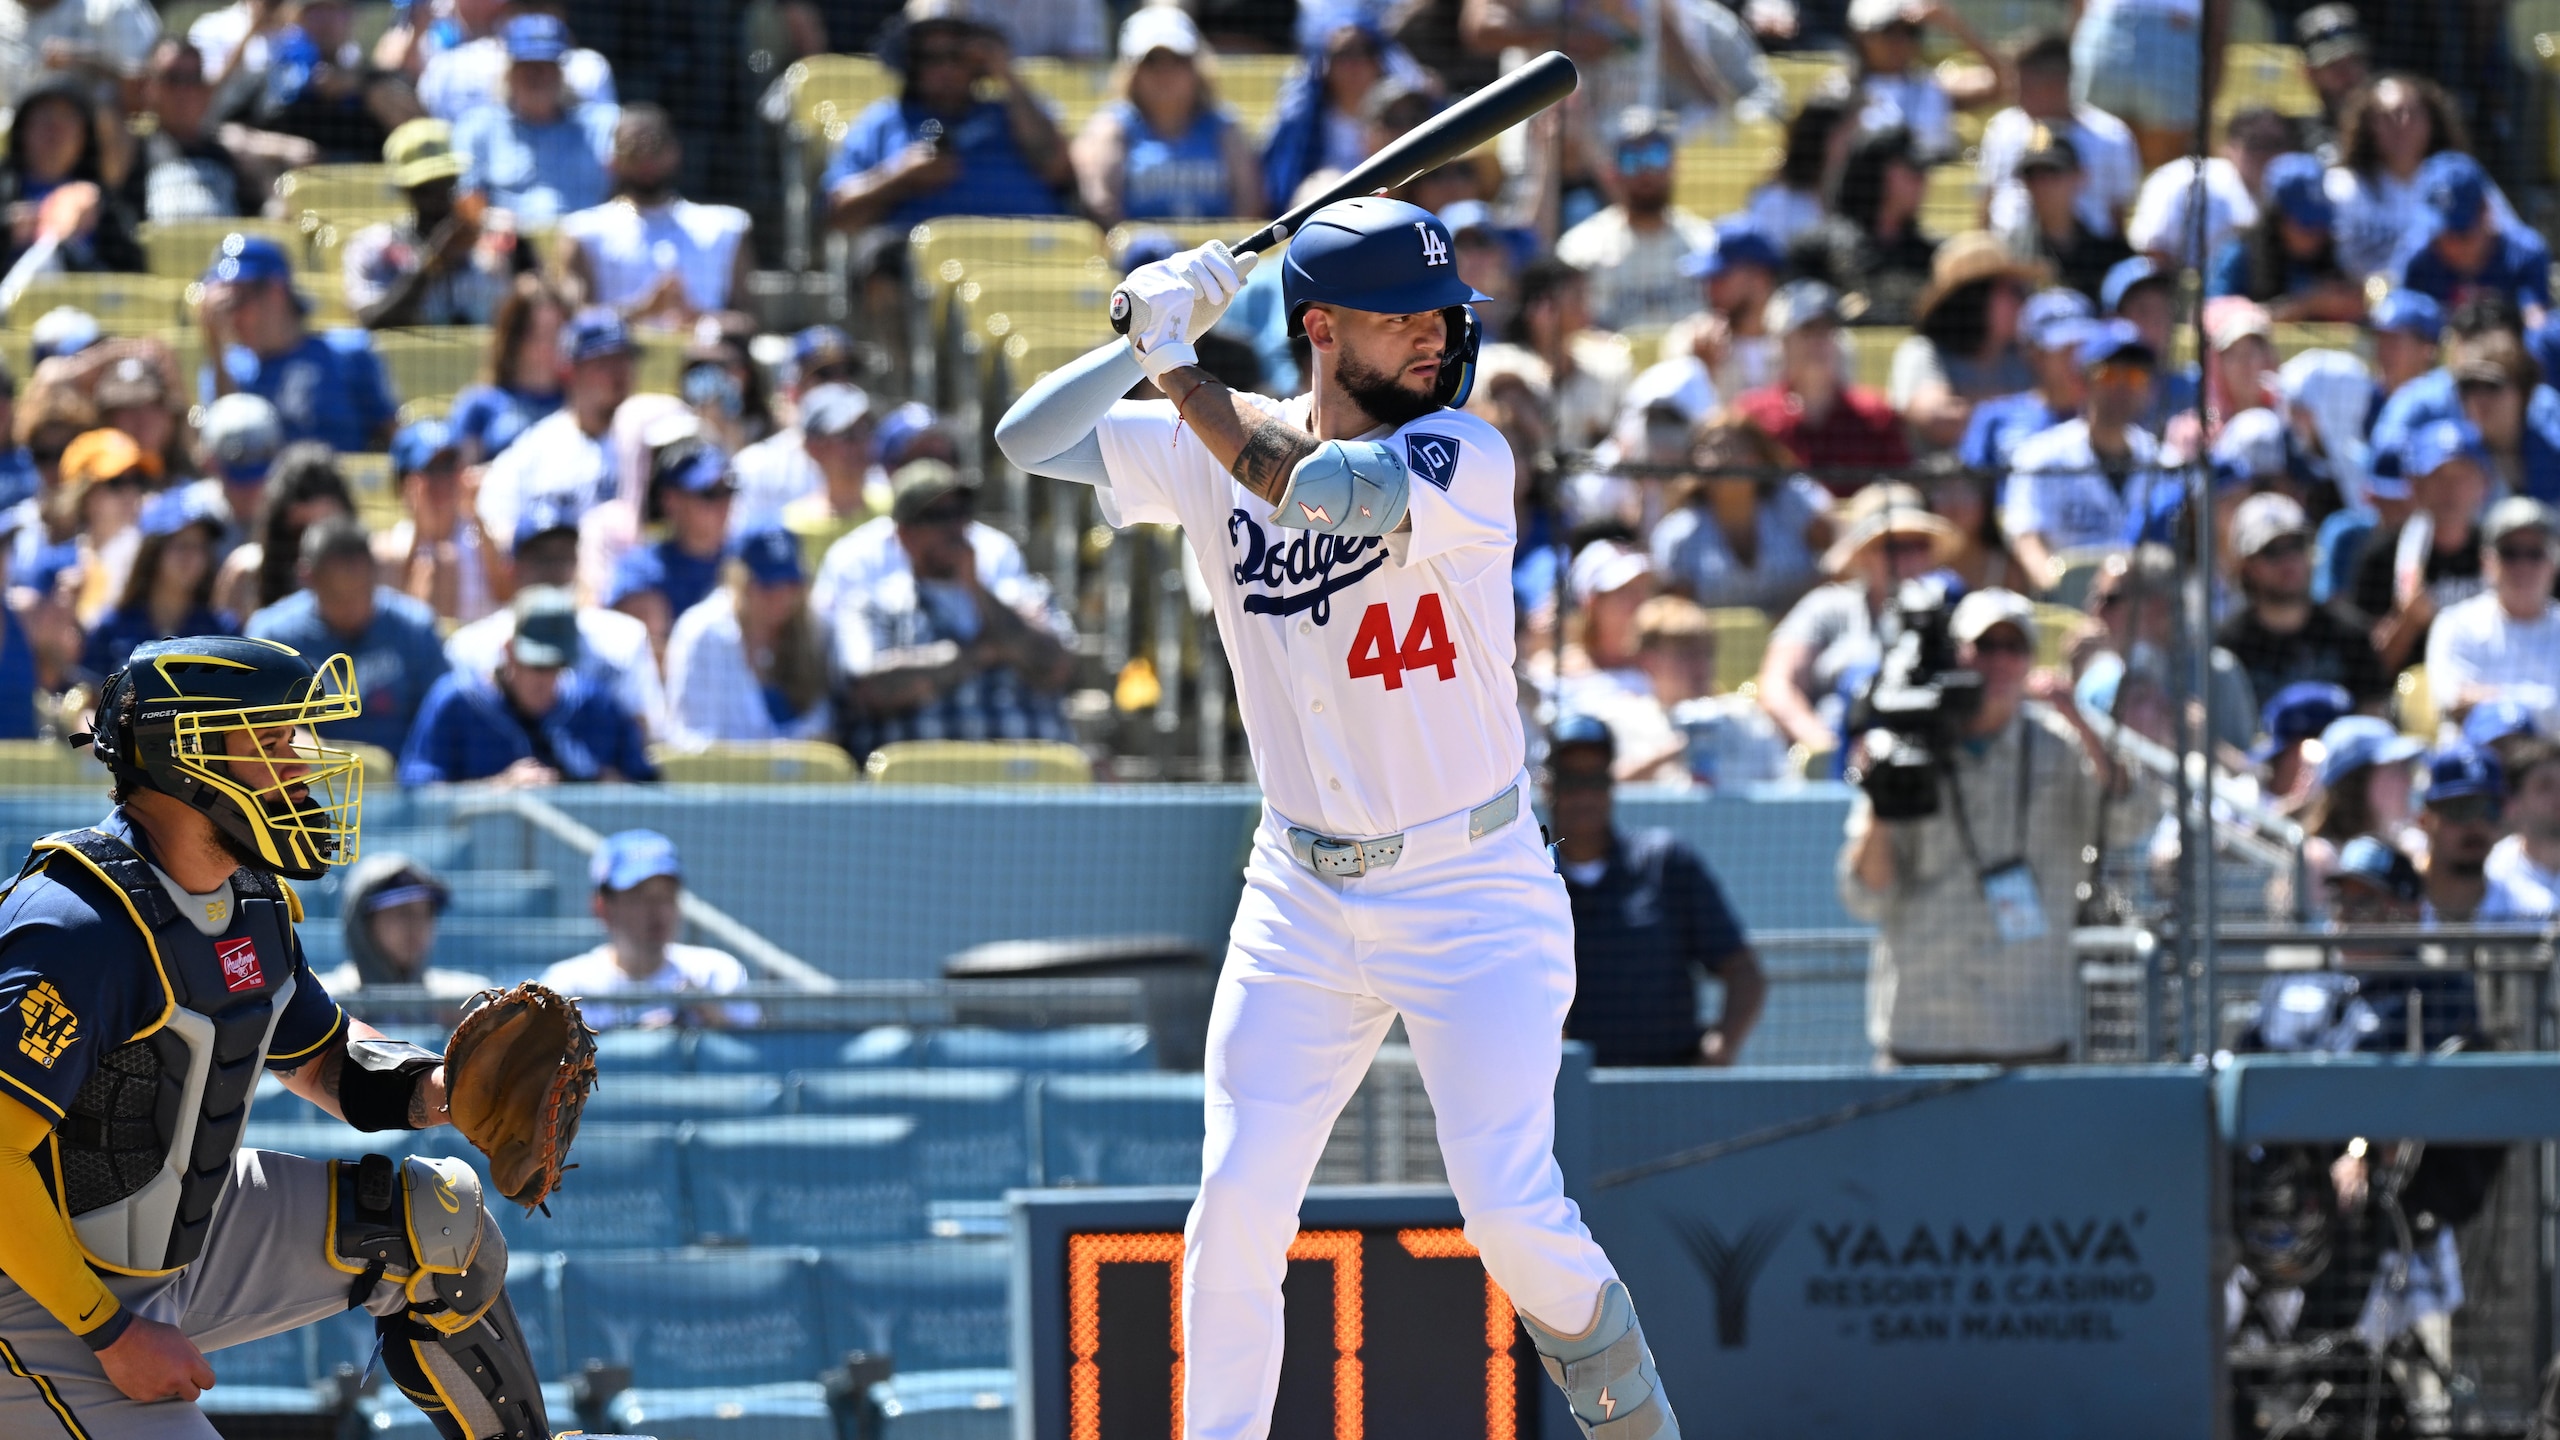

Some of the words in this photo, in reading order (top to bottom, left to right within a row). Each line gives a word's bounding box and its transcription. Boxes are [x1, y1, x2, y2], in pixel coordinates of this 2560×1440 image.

[1415, 221, 1449, 266] LA
[1228, 508, 1389, 626] Dodge
[1346, 592, 1457, 691] 44
[1805, 1274, 1956, 1307] RESORT
[1970, 1273, 1995, 1305] &
[2004, 1270, 2156, 1305] CASINO
[1871, 1313, 1949, 1344] SAN
[1961, 1312, 2121, 1342] MANUEL
